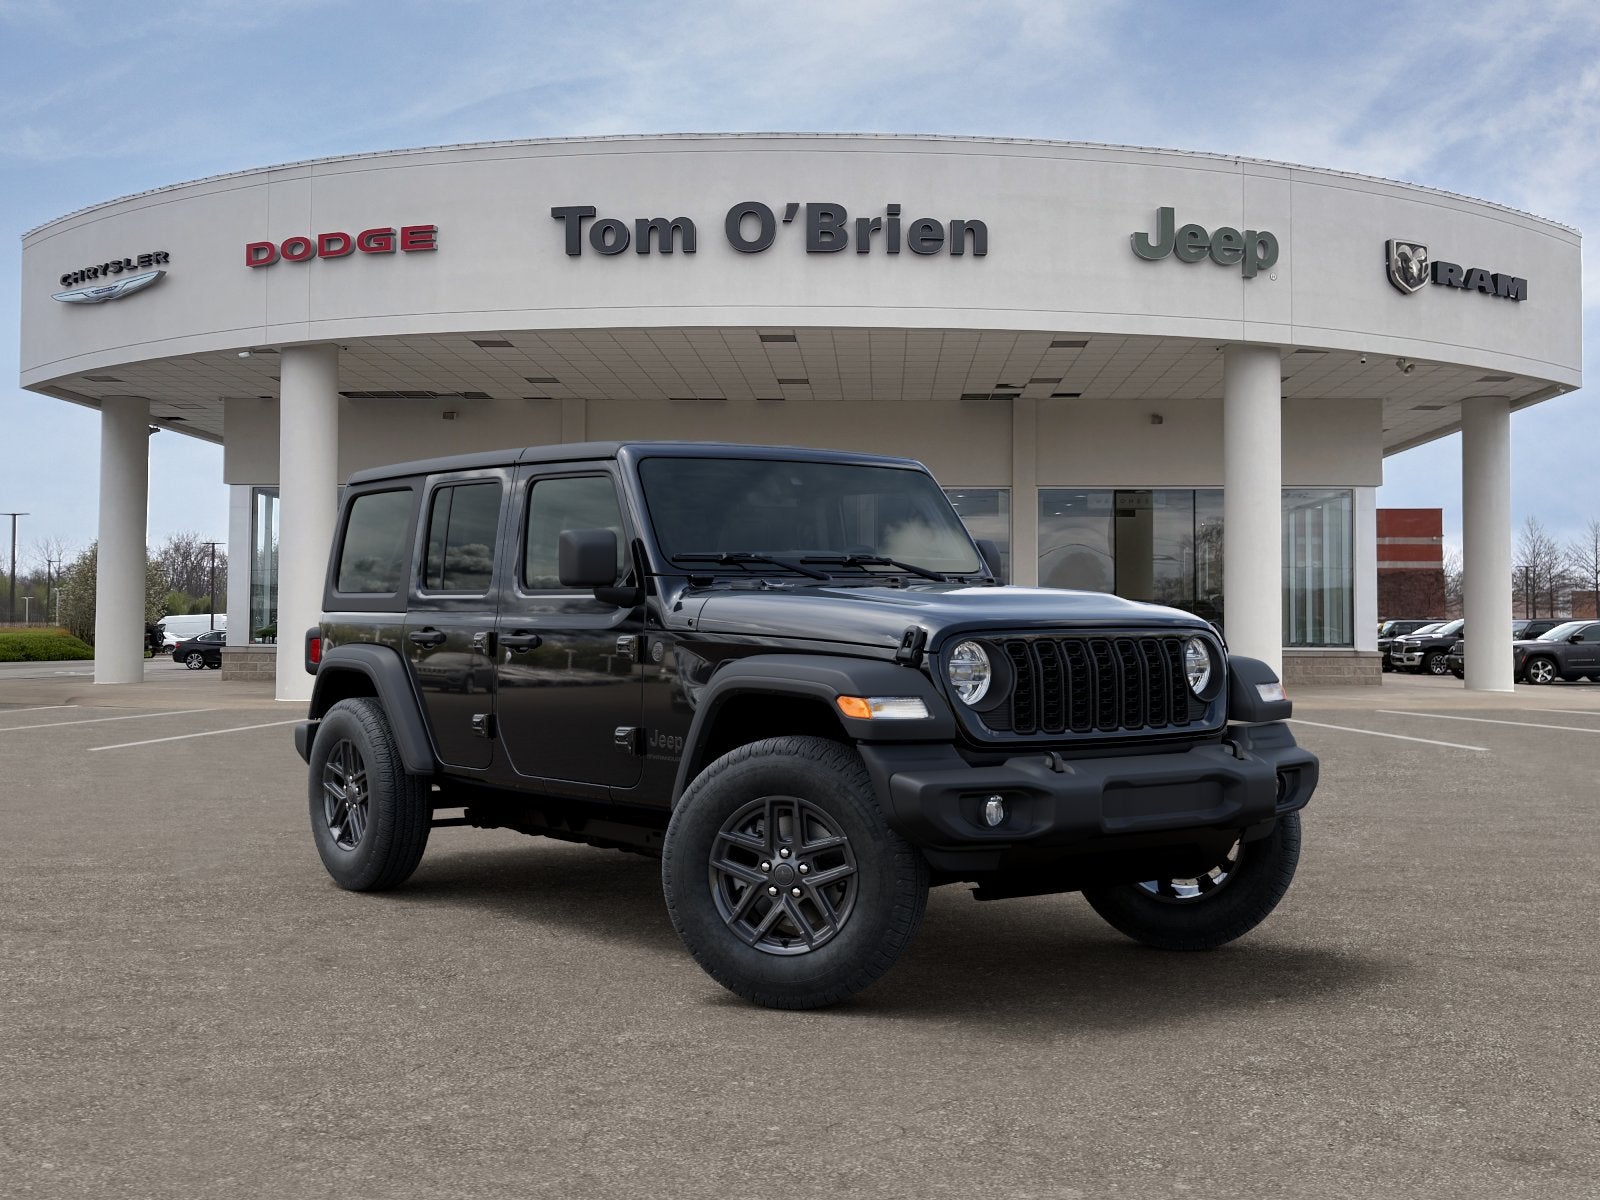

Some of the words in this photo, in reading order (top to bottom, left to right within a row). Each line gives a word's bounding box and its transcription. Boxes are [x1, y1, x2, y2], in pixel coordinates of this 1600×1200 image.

[245, 224, 438, 268] DODGE
[551, 205, 697, 256] Tom
[725, 201, 989, 256] O'Brien
[1130, 206, 1279, 279] Jeep
[59, 250, 170, 287] CHRYSLER
[1431, 260, 1528, 301] RAM
[649, 729, 683, 753] Jeep
